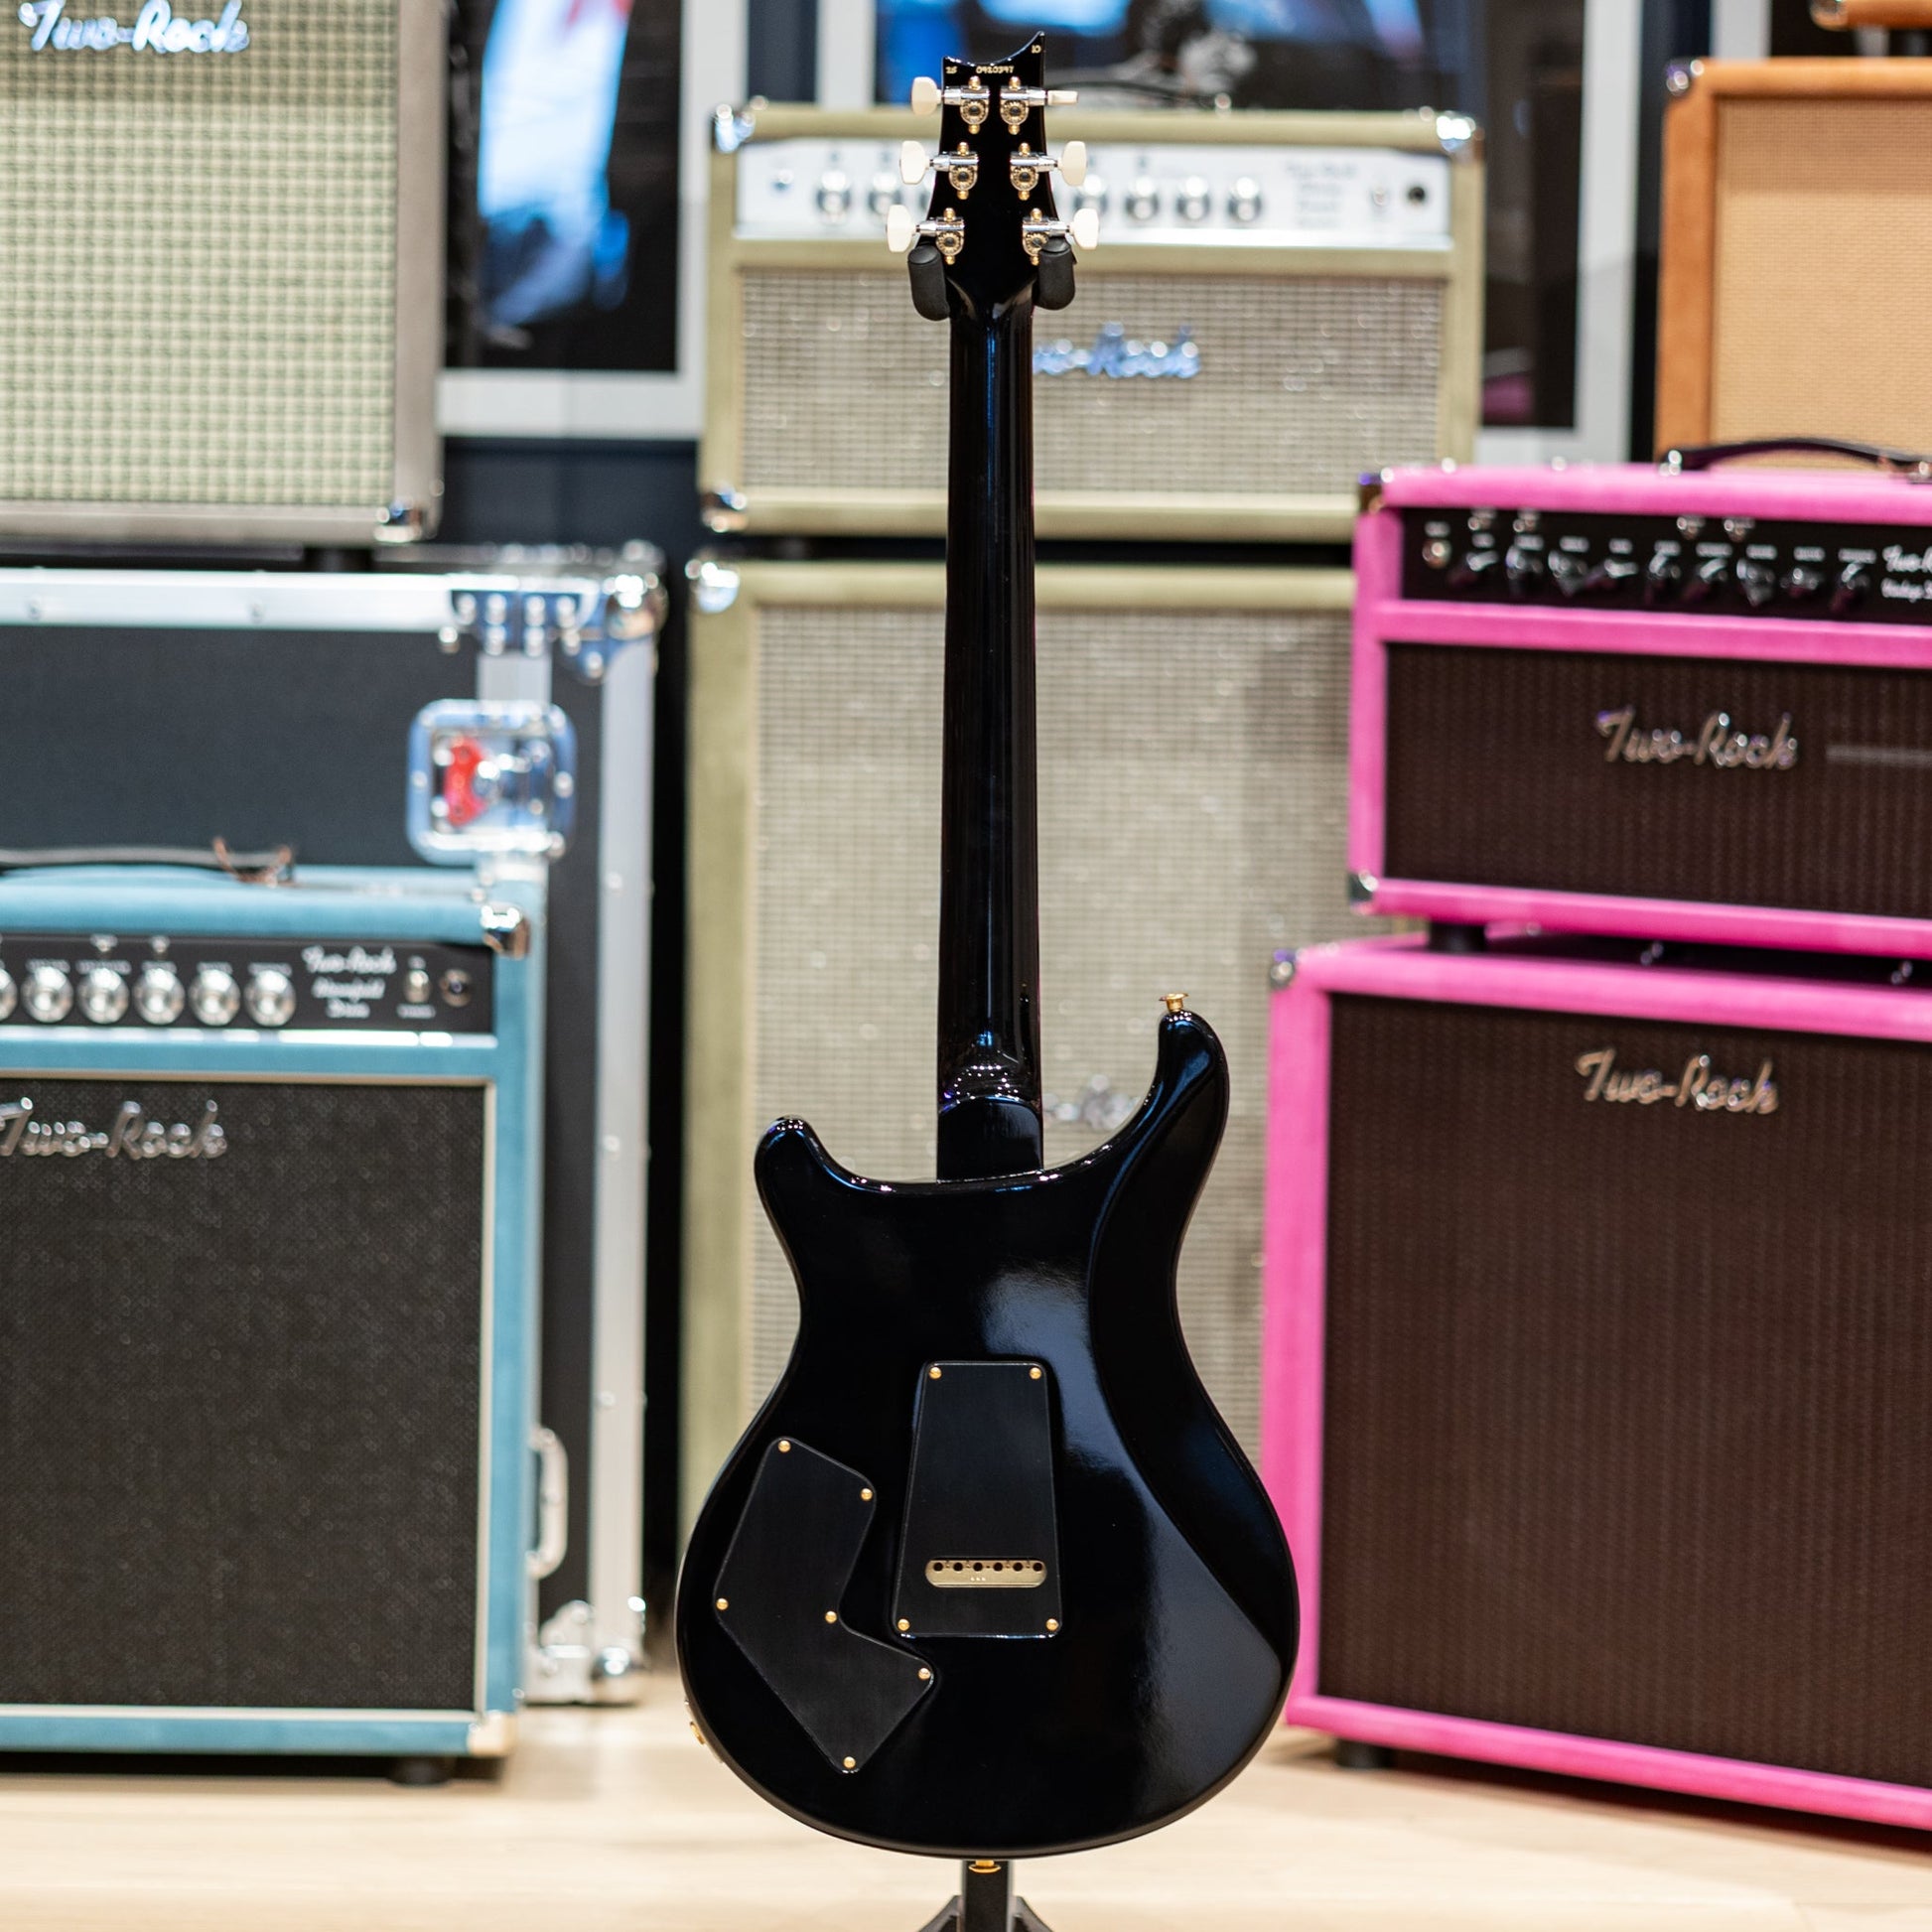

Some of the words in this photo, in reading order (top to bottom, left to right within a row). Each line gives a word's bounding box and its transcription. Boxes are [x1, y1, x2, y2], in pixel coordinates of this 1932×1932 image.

[17, 0, 250, 54] Two-Rock
[1033, 320, 1201, 379] o-Rock
[1594, 703, 1799, 771] Two-Rock
[1574, 1047, 1780, 1116] Two-Rock
[0, 1096, 228, 1161] Two-Rock
